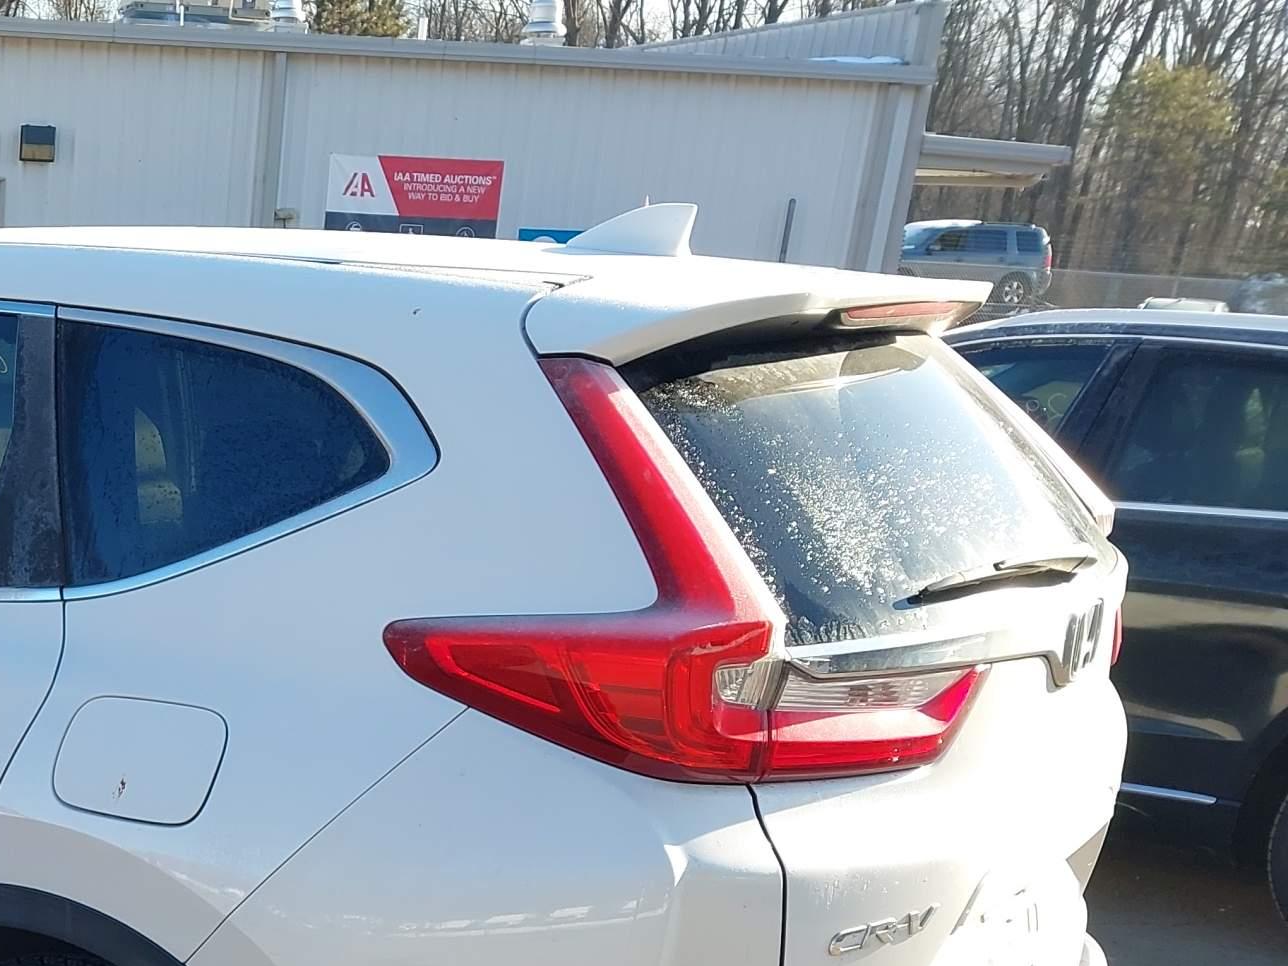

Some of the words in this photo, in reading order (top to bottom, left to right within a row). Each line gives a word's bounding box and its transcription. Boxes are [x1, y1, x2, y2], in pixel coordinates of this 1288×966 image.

[394, 172, 411, 182] IAA
[412, 172, 442, 184] TIMED
[403, 182, 457, 193] INTRODUCING
[458, 185, 465, 193] A
[466, 185, 486, 194] NEW
[408, 191, 426, 201] WAY
[427, 192, 439, 201] TO
[439, 193, 453, 202] BID
[454, 194, 461, 202] &
[462, 194, 480, 203] BUY
